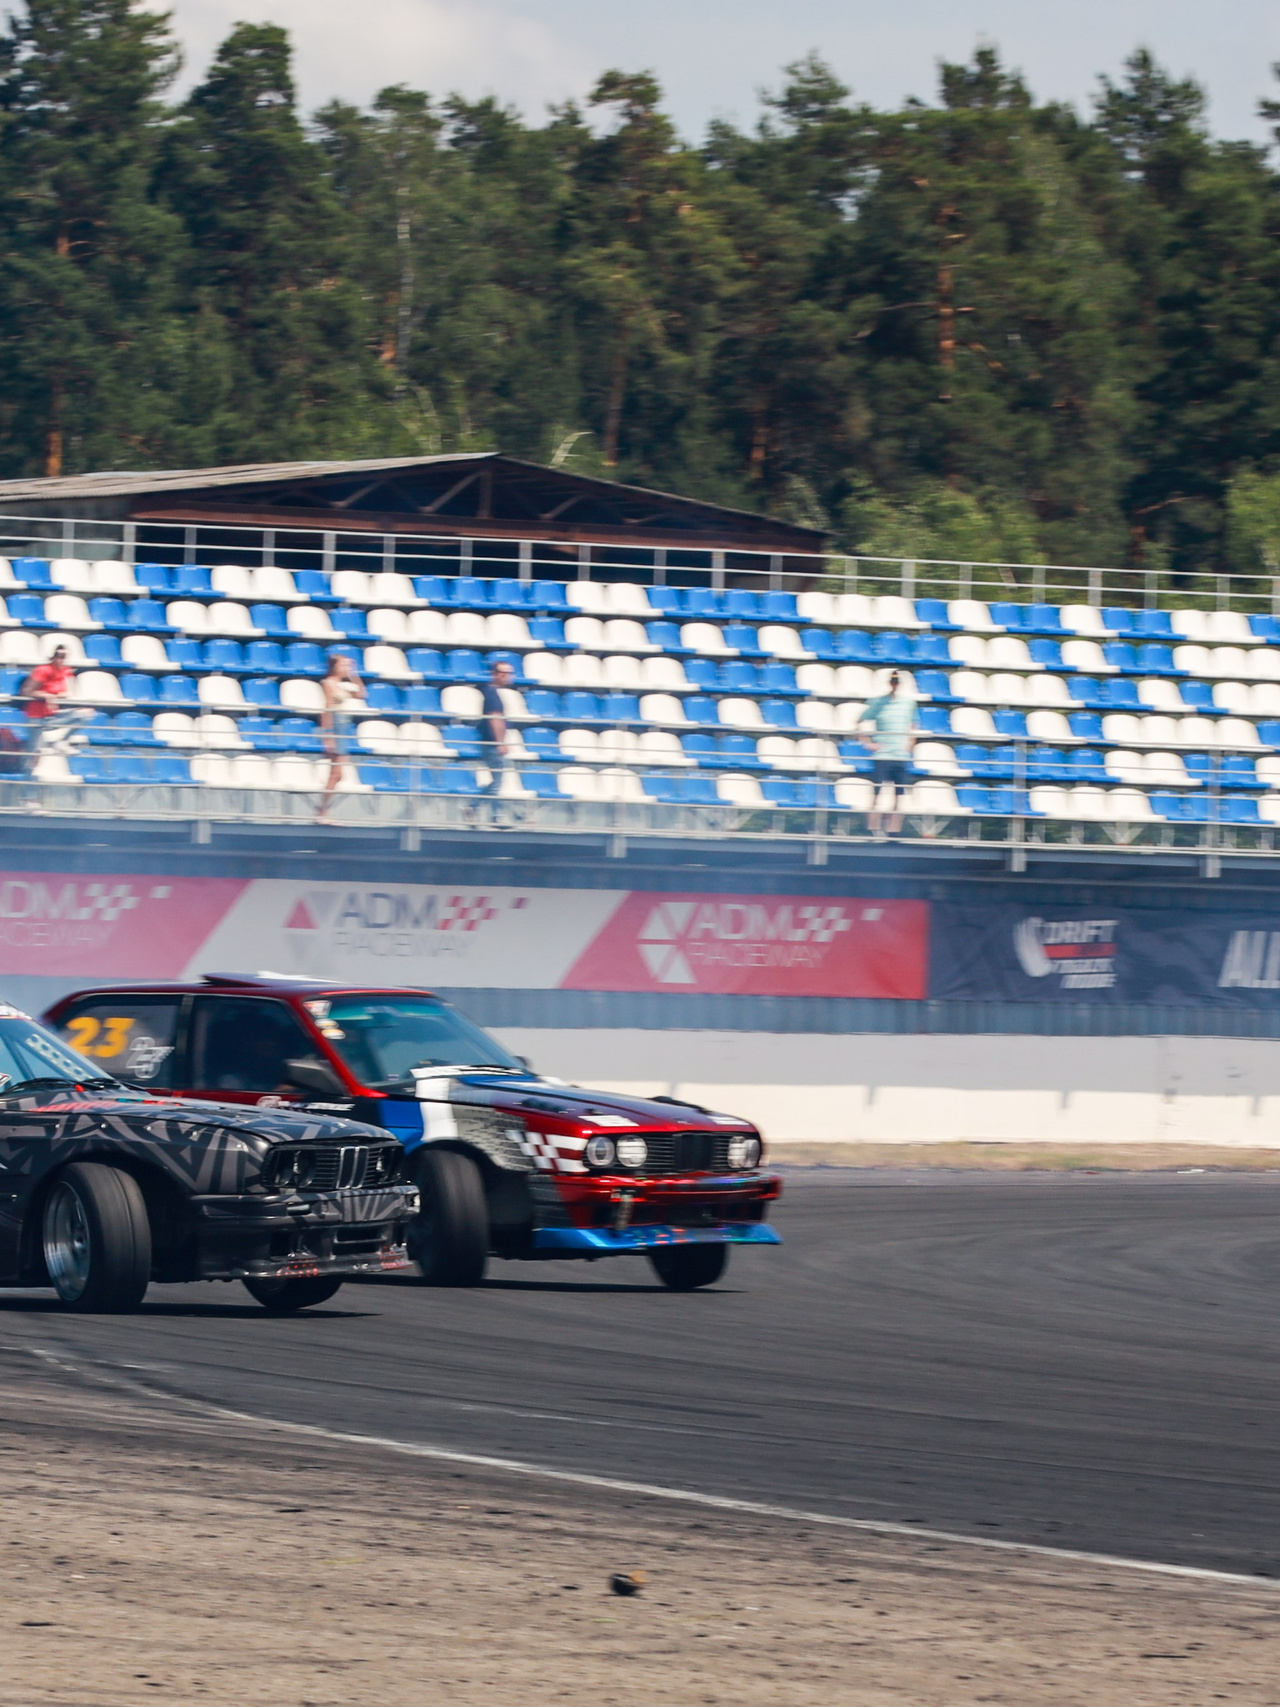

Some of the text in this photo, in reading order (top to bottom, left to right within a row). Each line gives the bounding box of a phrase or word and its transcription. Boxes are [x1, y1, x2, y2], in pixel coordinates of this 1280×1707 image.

[334, 892, 439, 929] ADM
[688, 902, 793, 941] ADM
[333, 932, 477, 957] RACEWAY
[1037, 919, 1119, 945] DRIFT
[688, 942, 831, 968] RACEWAY
[66, 1016, 136, 1058] 23
